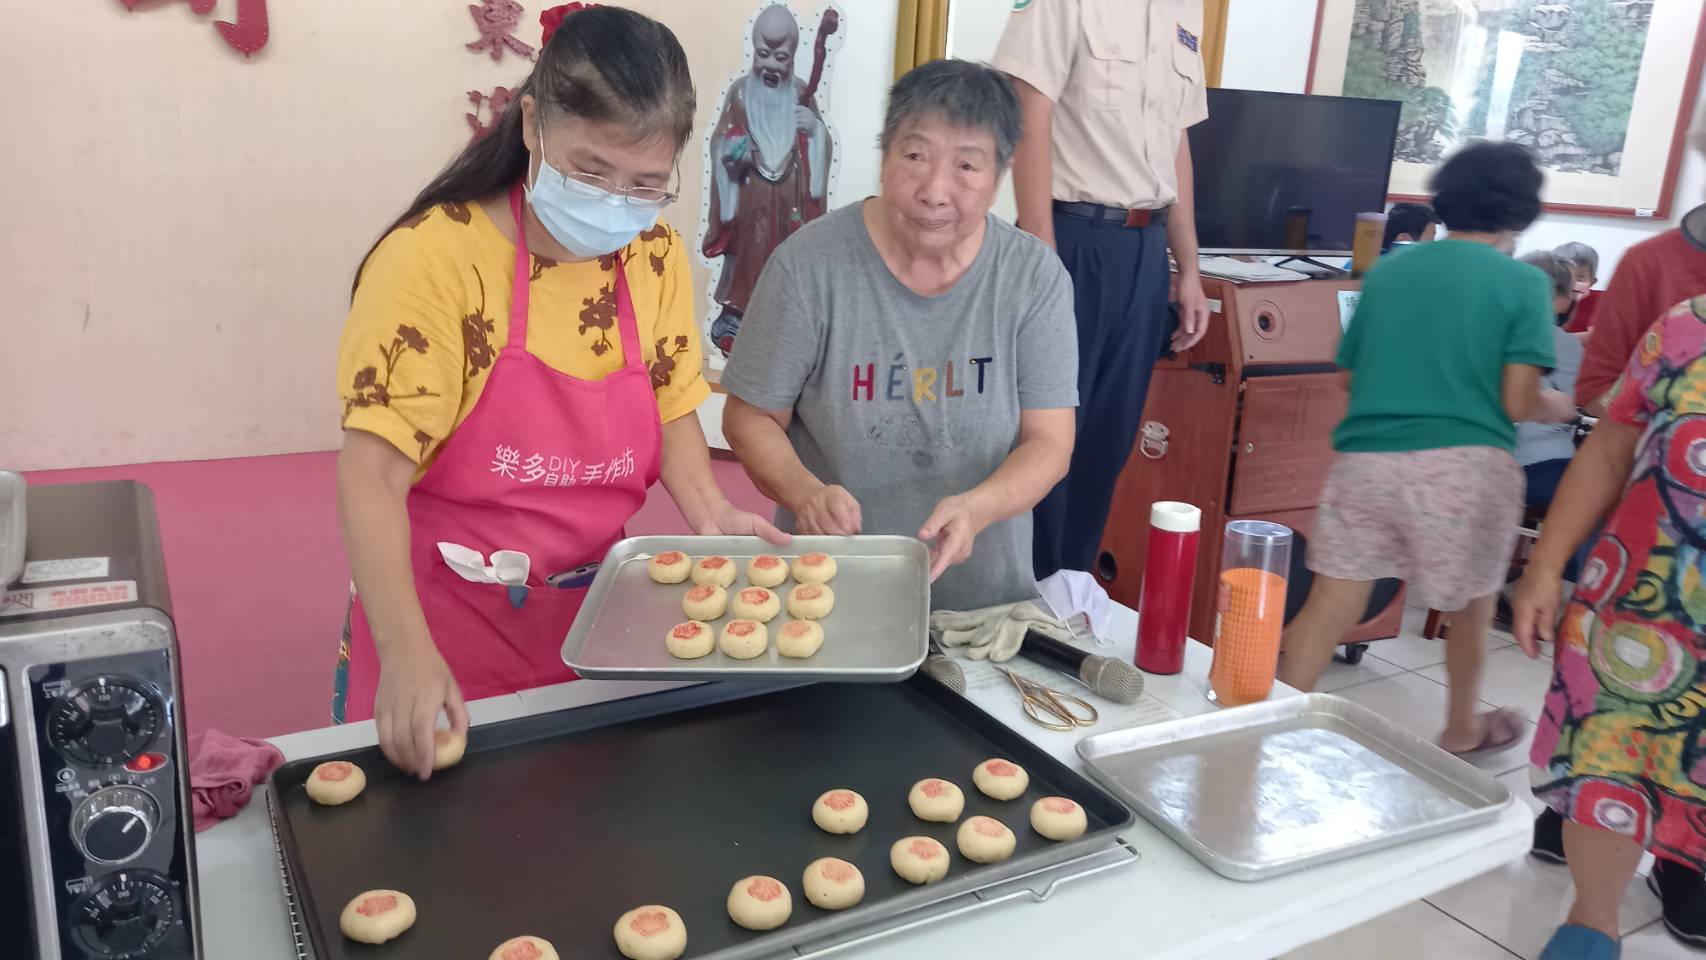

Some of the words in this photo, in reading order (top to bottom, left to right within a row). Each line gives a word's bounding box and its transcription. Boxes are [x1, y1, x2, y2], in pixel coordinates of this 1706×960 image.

[490, 443, 547, 484] 樂多
[549, 456, 580, 473] DIY
[581, 446, 635, 485] 手作坊
[544, 472, 577, 487] 自助
